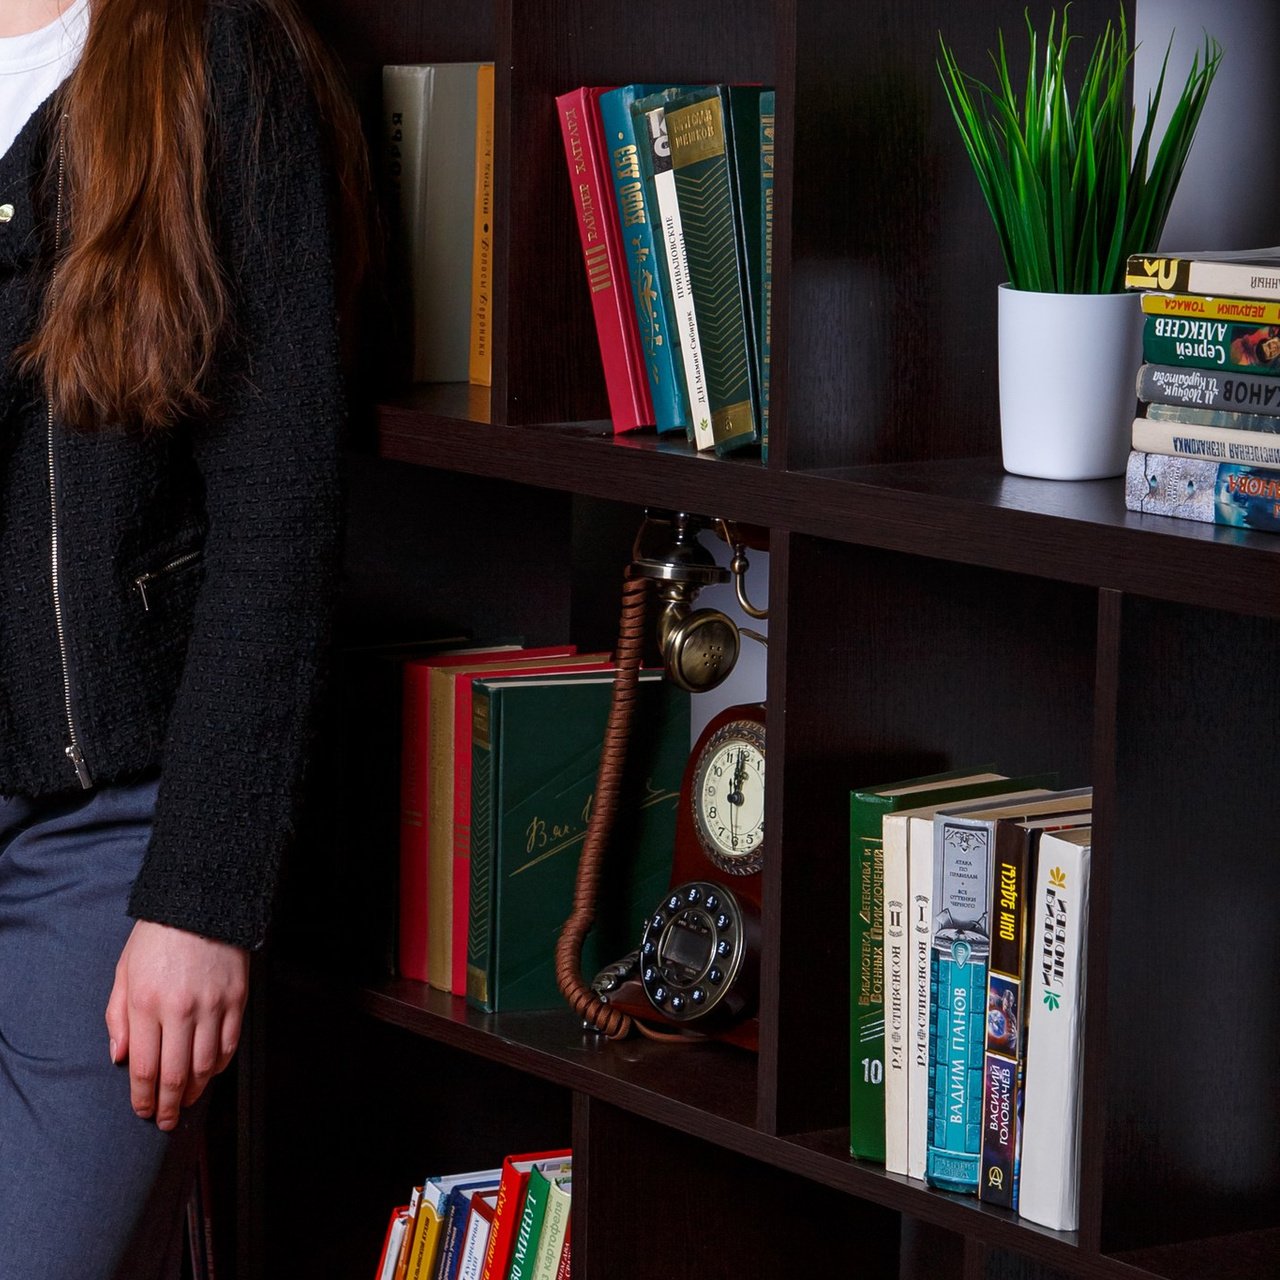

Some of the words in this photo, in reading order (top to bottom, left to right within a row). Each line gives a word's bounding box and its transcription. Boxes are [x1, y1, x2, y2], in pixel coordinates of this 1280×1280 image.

[566, 108, 586, 174] ХАГГАРД
[614, 144, 640, 179] АБЭ
[580, 184, 598, 242] РАЙДЕР
[620, 181, 646, 227] КОБО
[666, 216, 684, 299] ПРИВАЛОВСКИЕ
[1165, 299, 1205, 313] ТОМАСА
[1217, 304, 1266, 319] ДЕДУШКИ
[1155, 318, 1228, 342] АЛЕКСЕЕВ
[1175, 340, 1226, 365] Сергей
[1173, 436, 1225, 456] НЕЗНАКОМКА
[949, 871, 978, 880] ПРАВИЛАМ
[955, 859, 973, 867] АТАКА
[950, 894, 977, 903] ОТТЕНКИ
[999, 913, 1015, 941] ОНИ
[1043, 887, 1057, 987] ИСТОРИЯ
[1054, 899, 1069, 988] ЛЮБВИ
[952, 987, 967, 1051] ПАНОВ
[861, 1057, 883, 1084] 10
[950, 1059, 965, 1124] ВАДИМ
[989, 1065, 1001, 1131] ВАСИЛИЙ
[999, 1068, 1011, 1146] ГОЛОВАЧЕВ
[421, 1217, 431, 1243] КУХНИ
[517, 1189, 538, 1267] МИНУТ
[543, 1201, 564, 1274] картофеля
